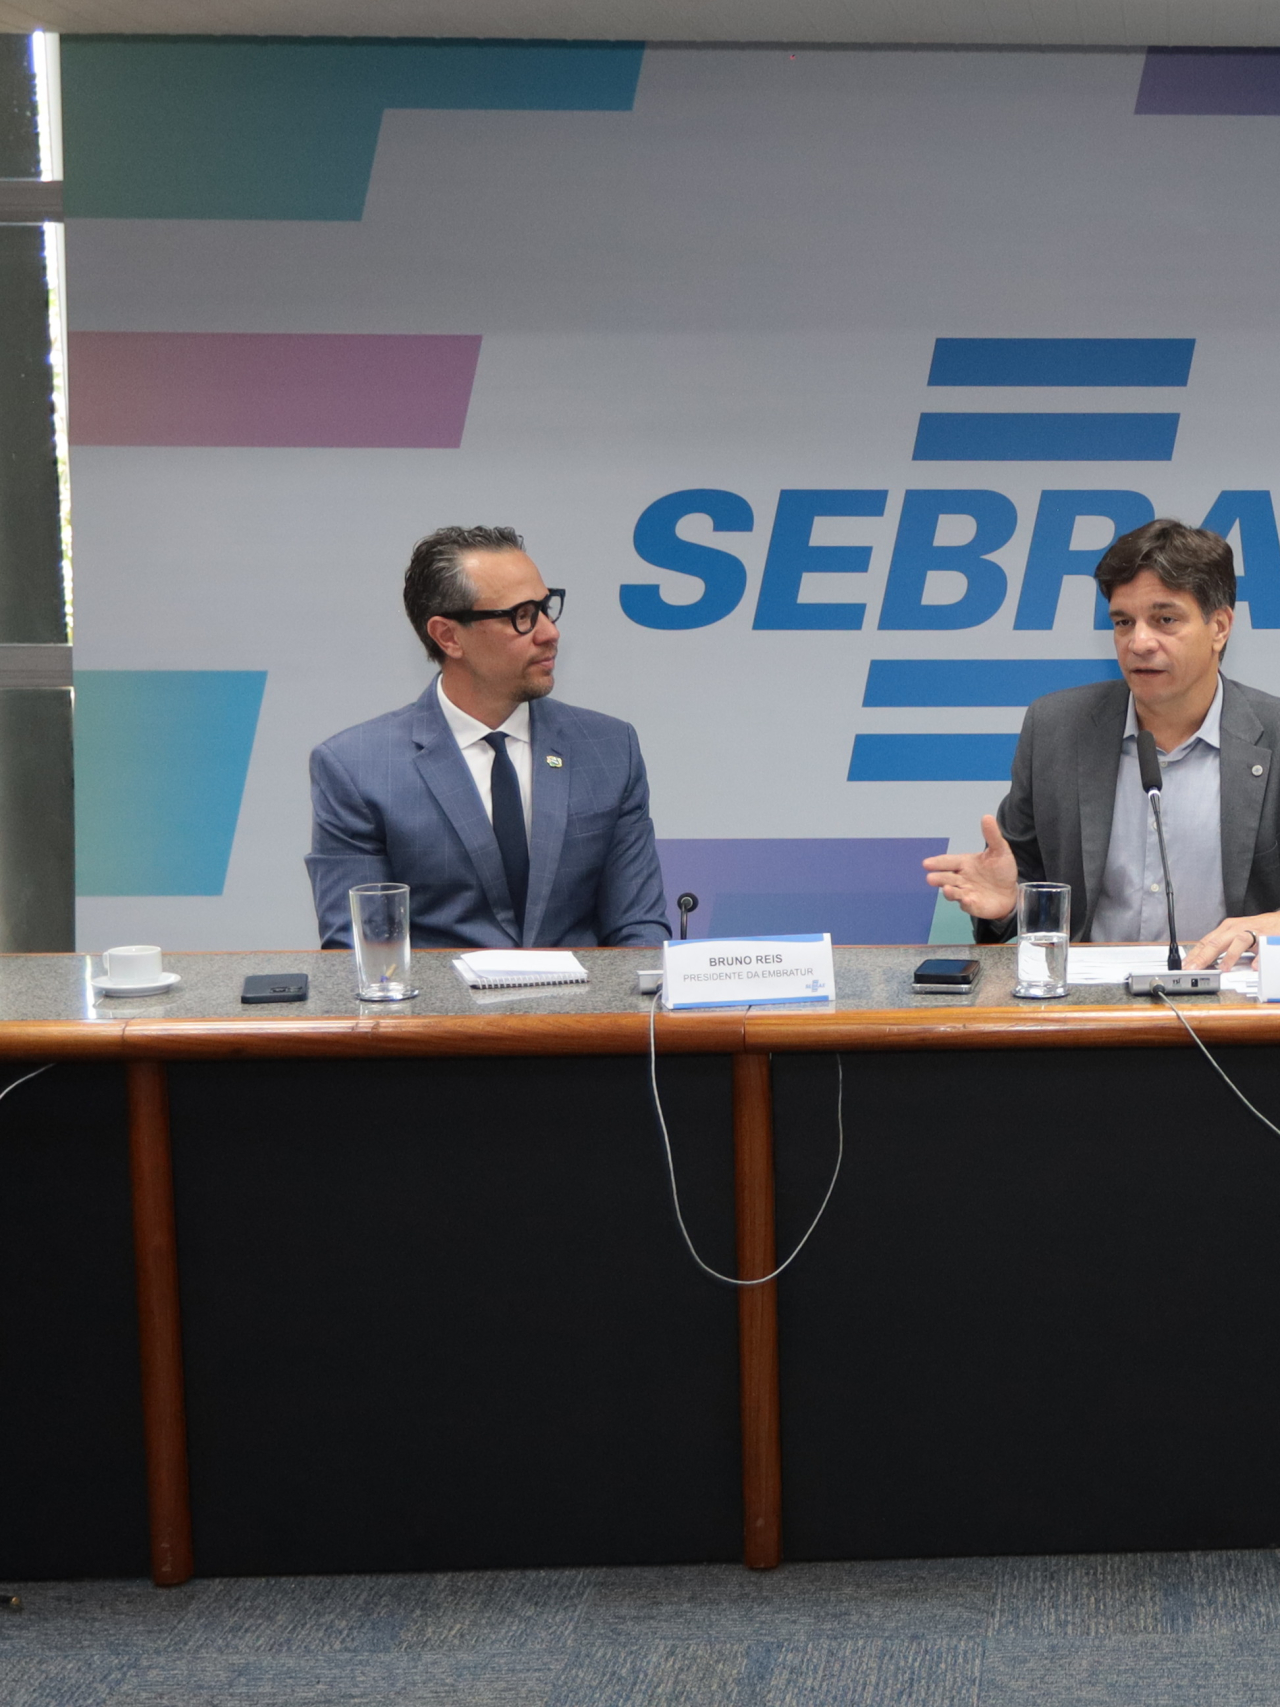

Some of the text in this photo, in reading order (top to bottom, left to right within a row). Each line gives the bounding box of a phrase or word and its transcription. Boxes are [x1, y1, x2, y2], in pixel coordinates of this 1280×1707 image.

[709, 954, 783, 967] BRUNO REIS
[683, 968, 814, 982] PRESIDENTE DA EMBRATUR
